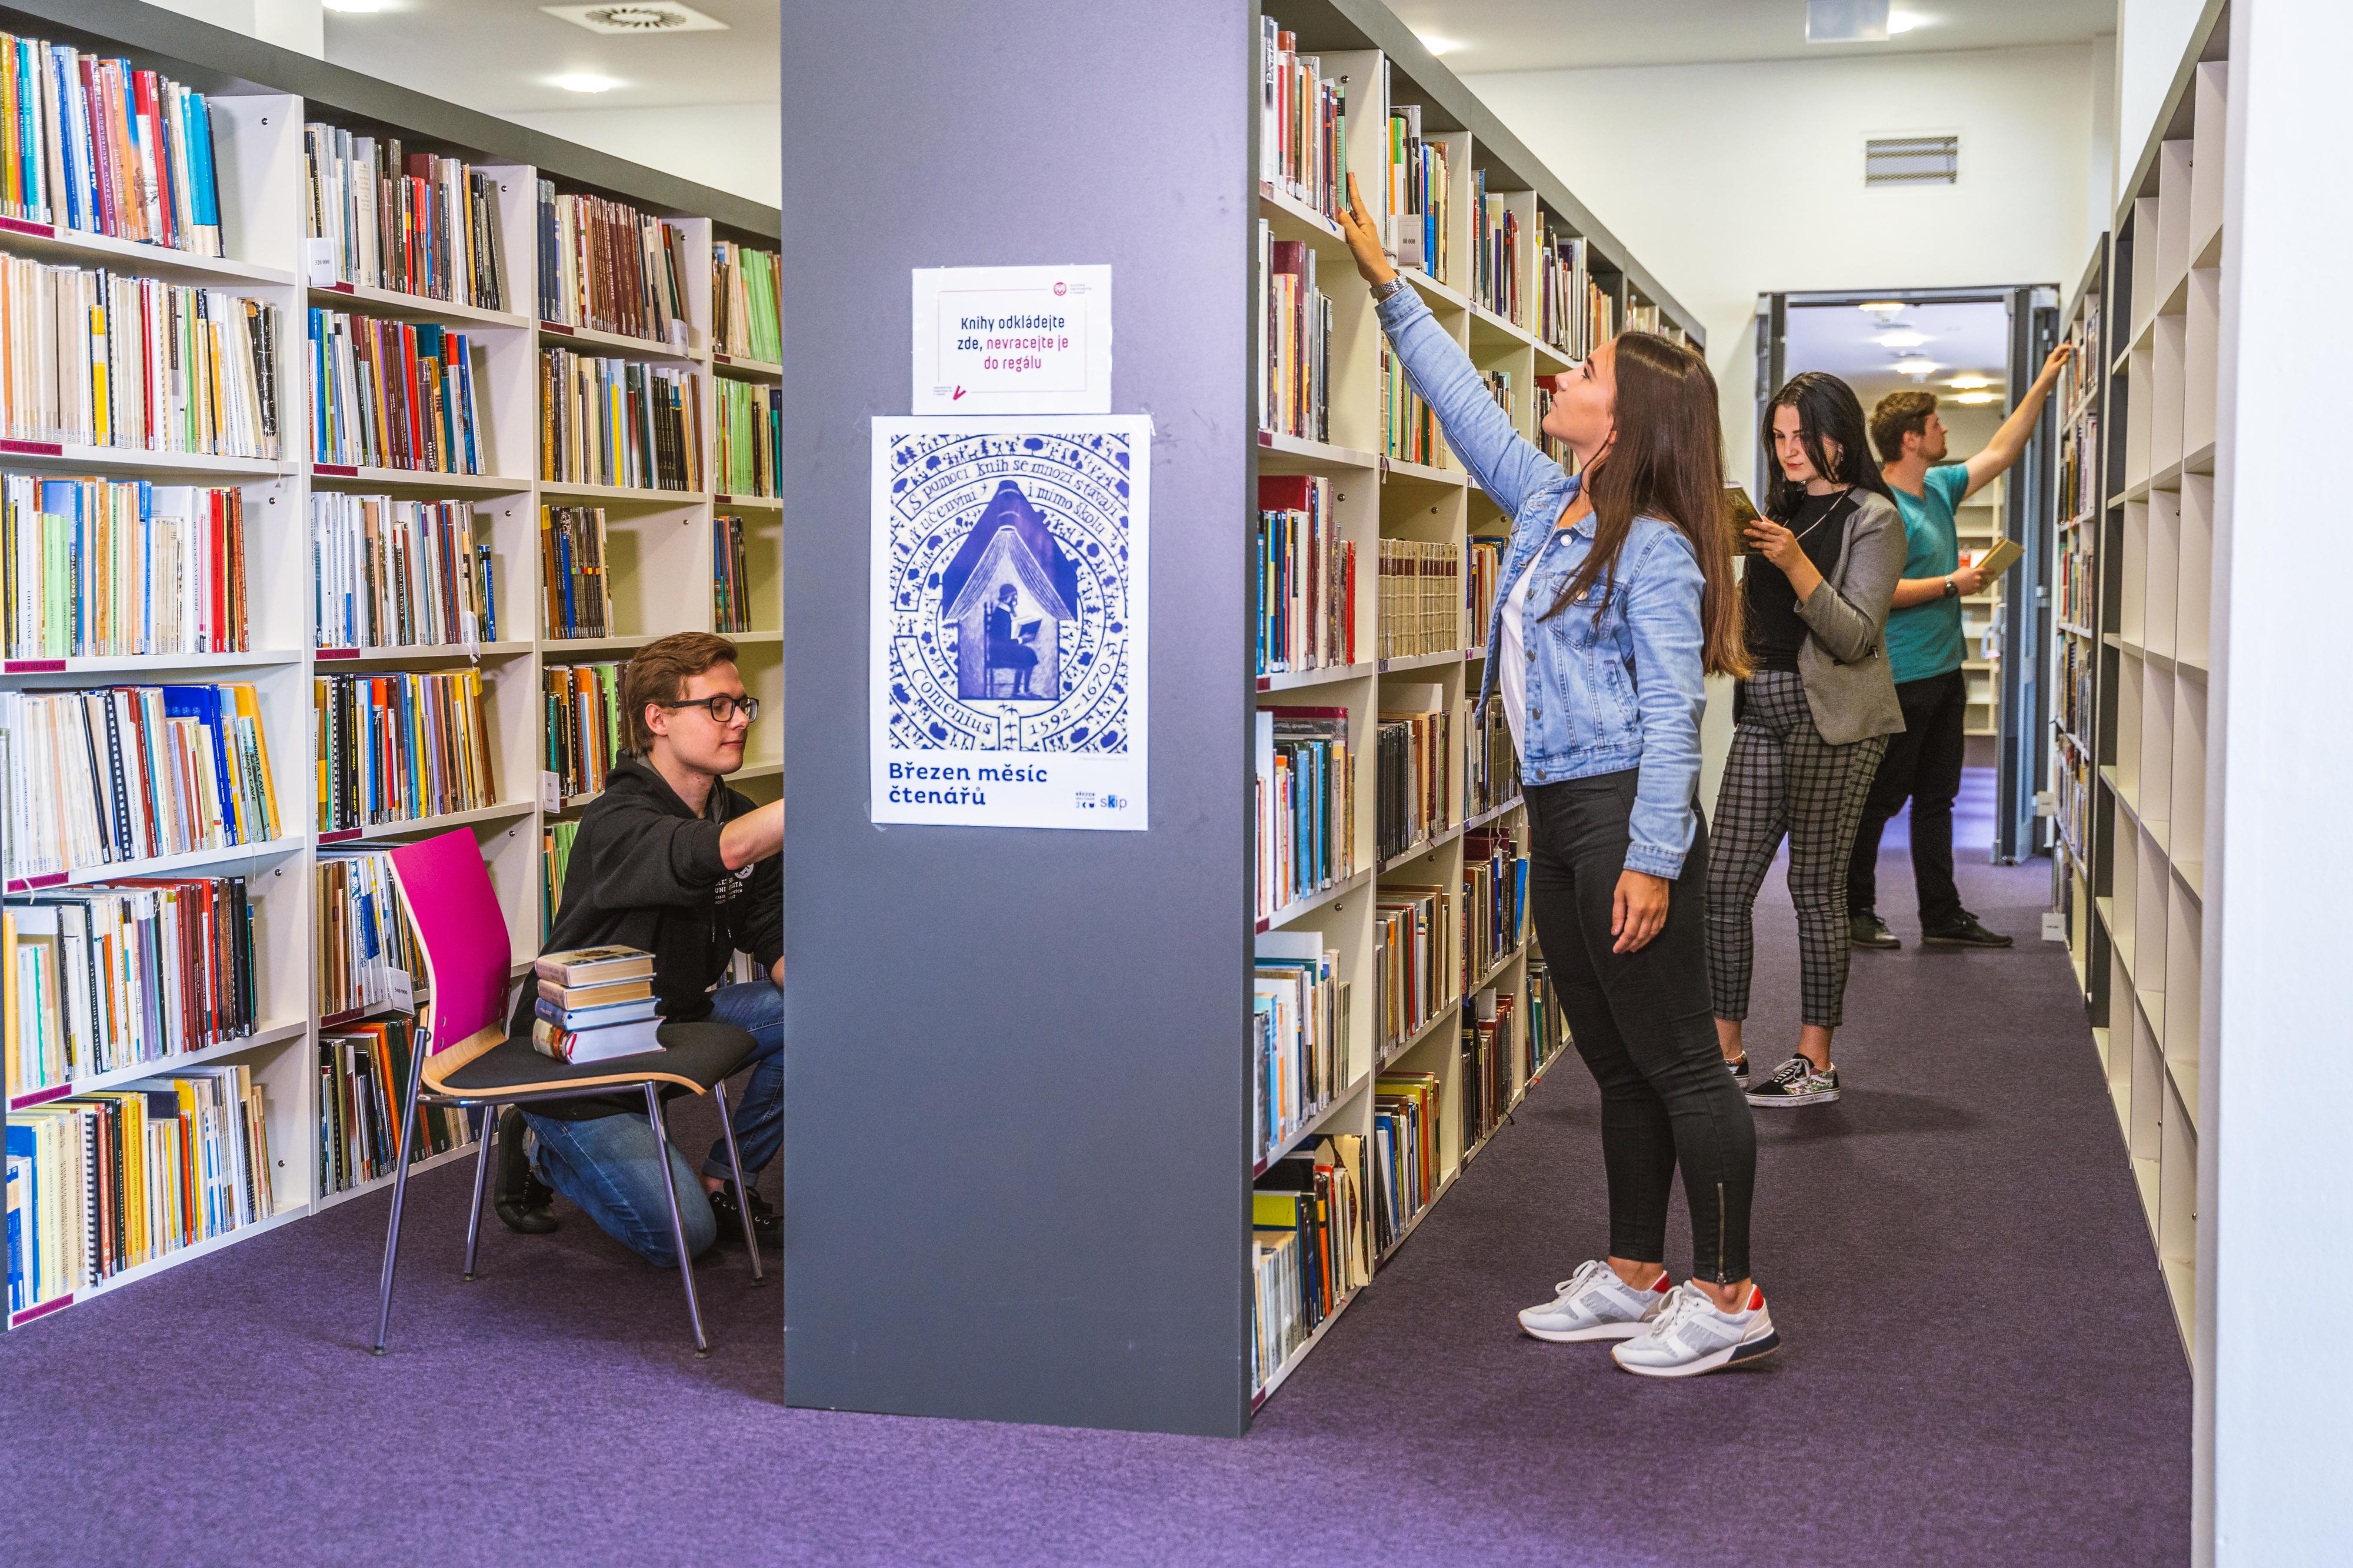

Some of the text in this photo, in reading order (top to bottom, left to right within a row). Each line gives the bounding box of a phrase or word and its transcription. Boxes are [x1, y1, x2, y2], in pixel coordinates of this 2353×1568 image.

[98, 113, 108, 167] ARCHEOLOGIE
[961, 315, 1065, 332] Knihy odkládejte
[958, 335, 1068, 352] zde, nevracejte je
[984, 356, 1041, 372] do regálu
[909, 494, 922, 510] S
[975, 458, 1009, 477] knih
[1014, 459, 1029, 472] se
[921, 482, 1106, 535] učenými i mimo školu
[399, 584, 404, 593] DO
[911, 669, 993, 736] Comenius
[242, 735, 254, 777] TEMNATA
[251, 730, 262, 773] TEMNATA
[889, 762, 1048, 783] Březen měsíc
[889, 786, 986, 805] čtenářů
[1100, 795, 1127, 811] skip
